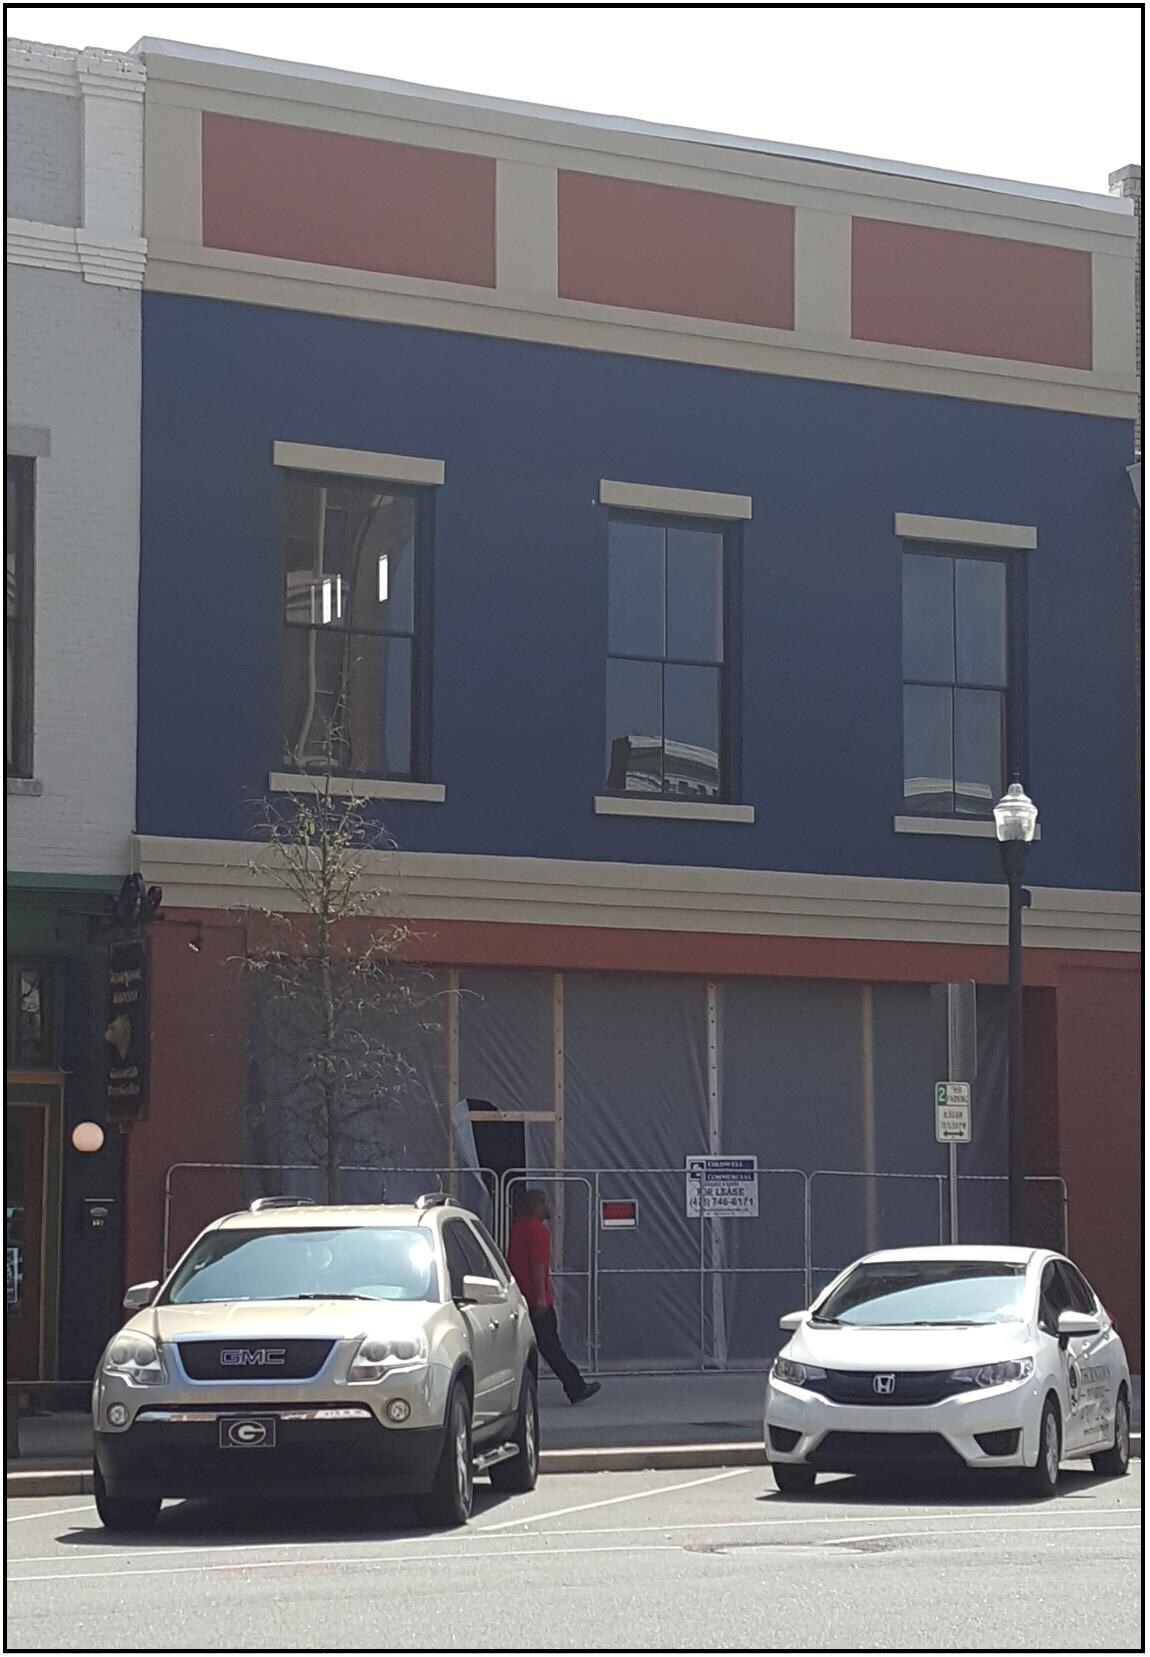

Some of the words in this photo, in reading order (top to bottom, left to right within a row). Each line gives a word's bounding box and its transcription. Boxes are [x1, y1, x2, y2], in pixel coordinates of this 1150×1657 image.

[938, 1086, 946, 1102] 2
[696, 1187, 713, 1196] FOR
[715, 1187, 745, 1196] LEASE
[220, 1348, 286, 1366] GMC
